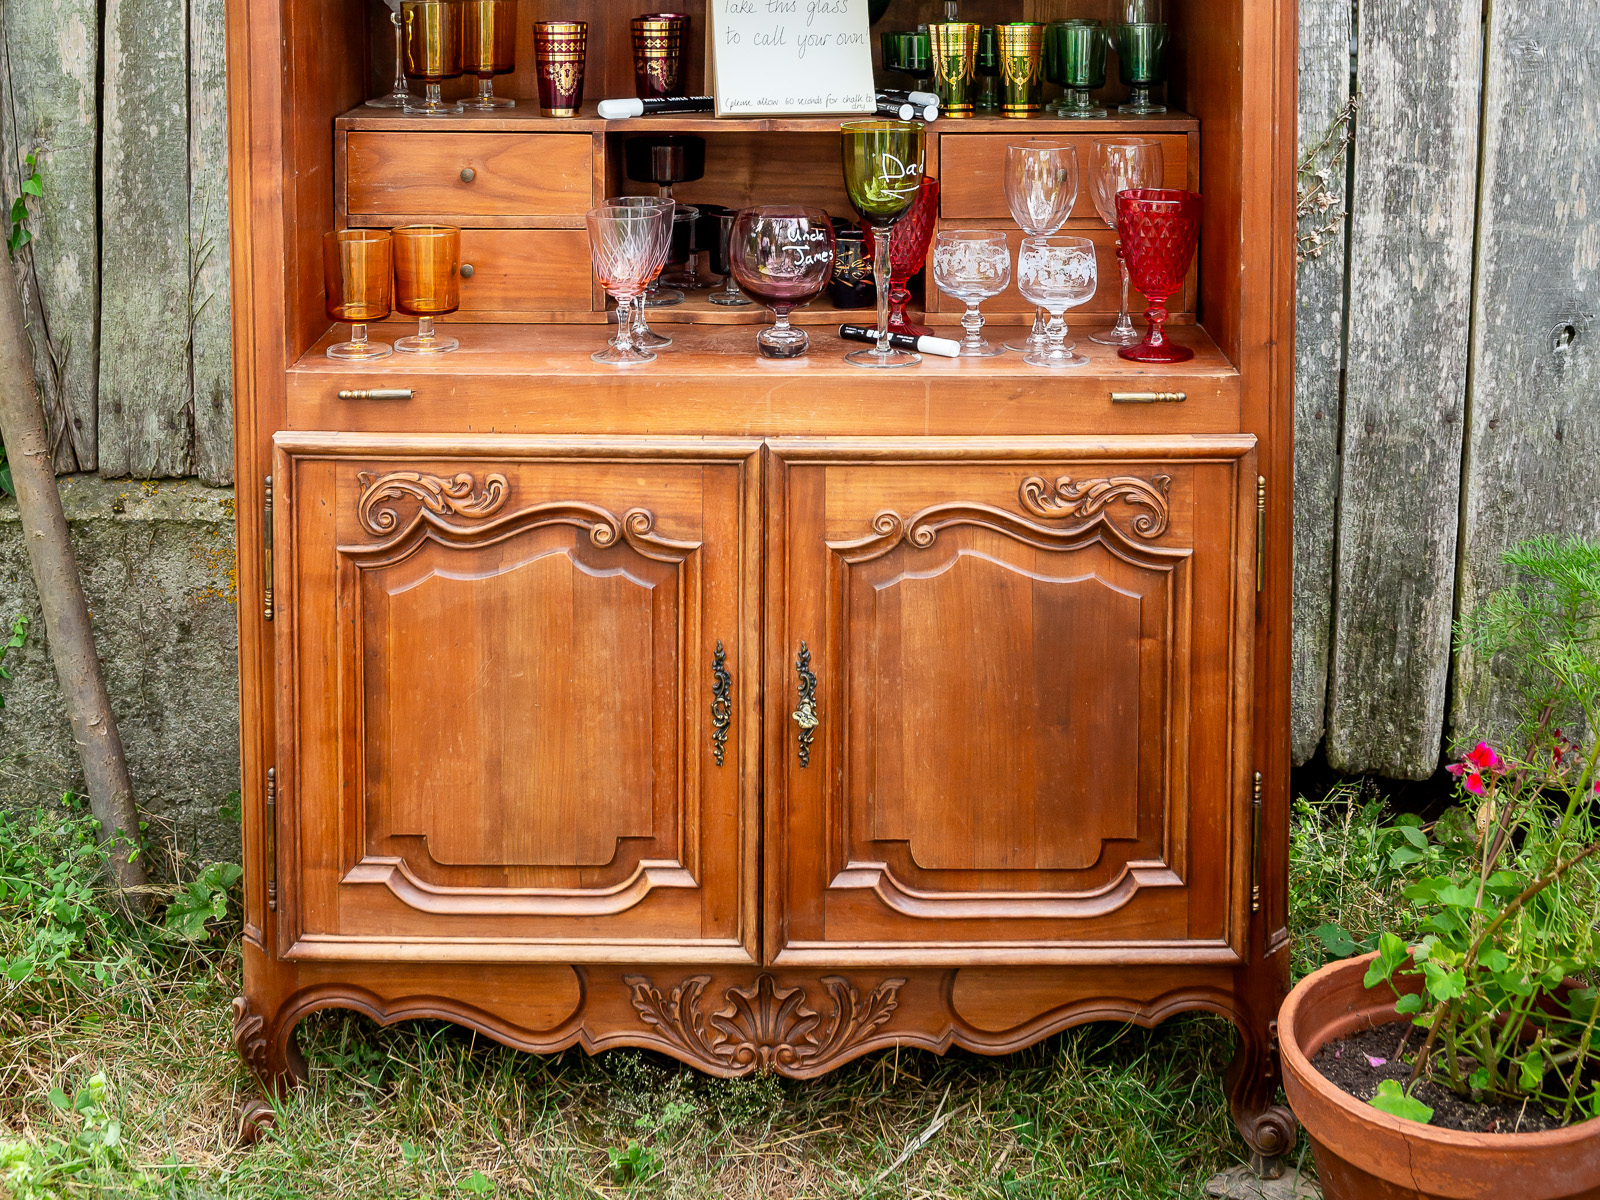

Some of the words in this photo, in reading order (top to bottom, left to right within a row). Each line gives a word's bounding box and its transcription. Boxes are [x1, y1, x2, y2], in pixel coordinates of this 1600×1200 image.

[725, 26, 741, 44] to
[753, 25, 786, 46] call
[797, 34, 832, 59] your
[757, 97, 778, 106] allow
[797, 96, 822, 105] seconds
[826, 93, 838, 108] for
[842, 94, 863, 103] chalk
[866, 93, 873, 103] to
[878, 150, 925, 183] Dad
[782, 245, 834, 266] James
